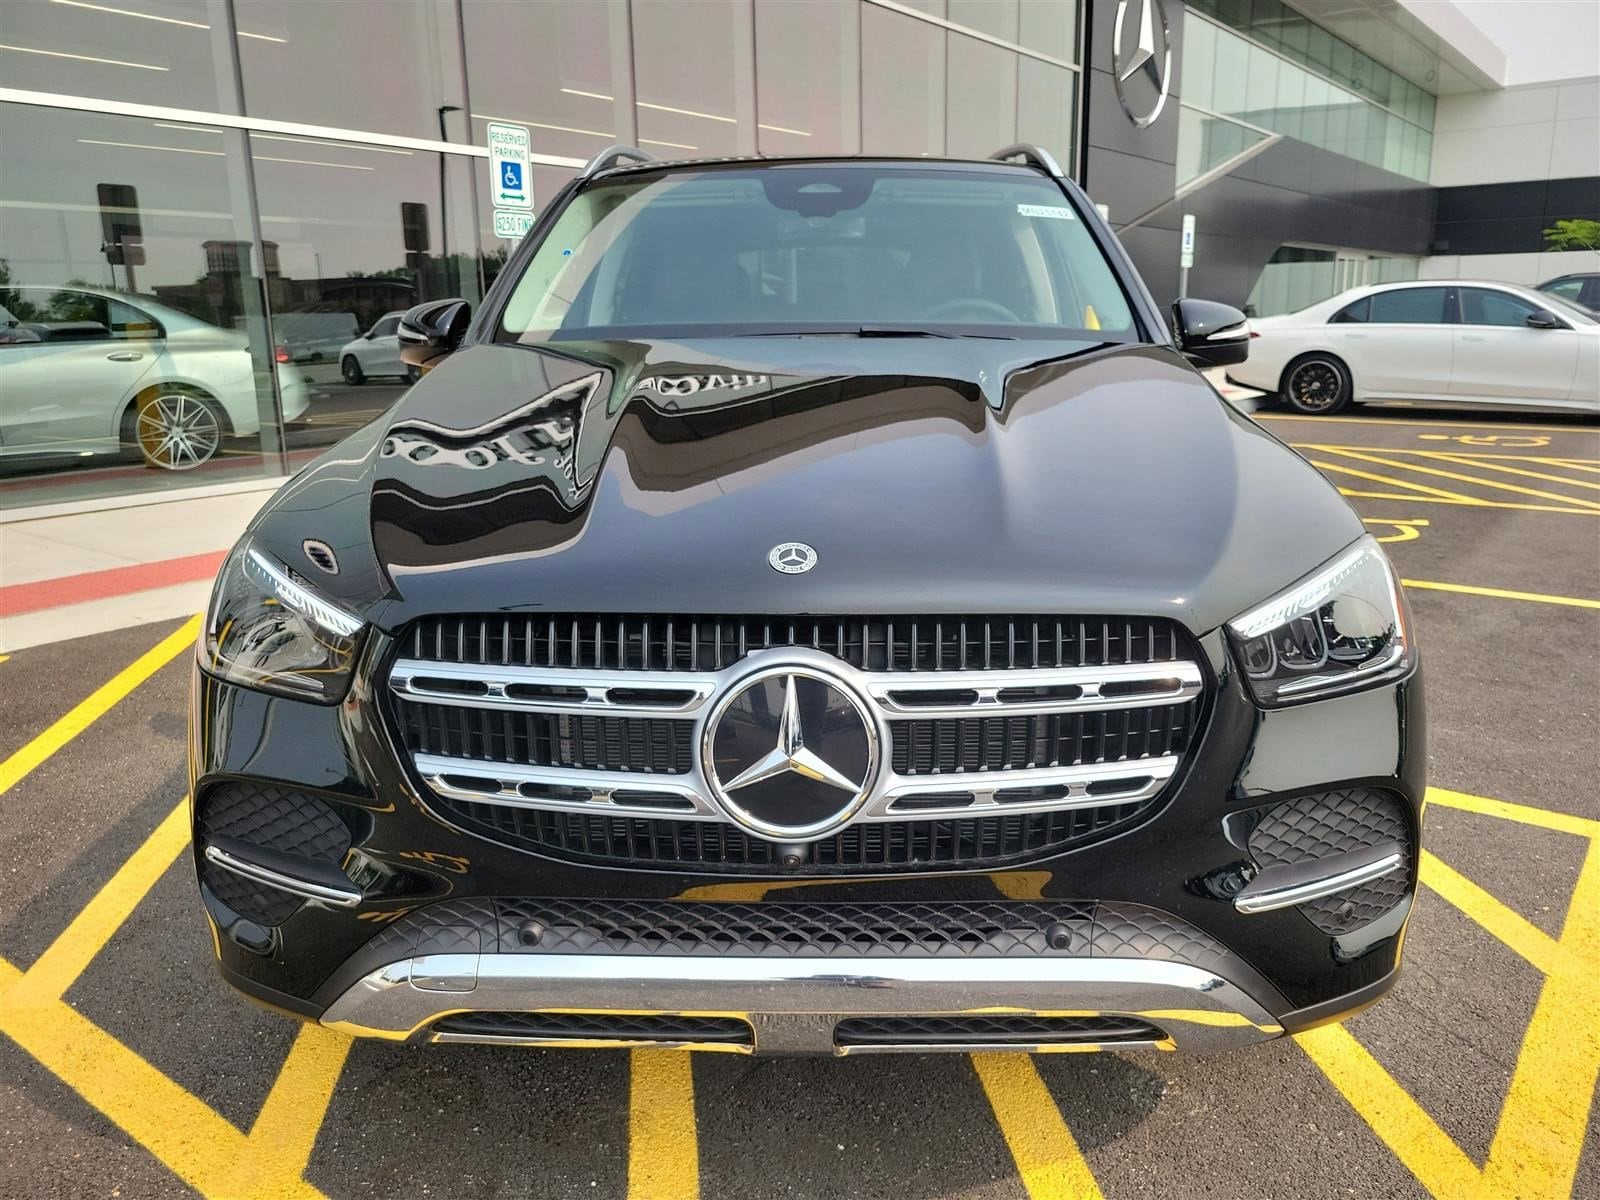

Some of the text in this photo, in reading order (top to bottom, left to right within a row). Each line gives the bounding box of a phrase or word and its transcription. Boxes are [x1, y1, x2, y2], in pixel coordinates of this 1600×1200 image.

[490, 131, 528, 146] RESERVED
[495, 147, 525, 161] PARKING
[497, 216, 515, 232] $250
